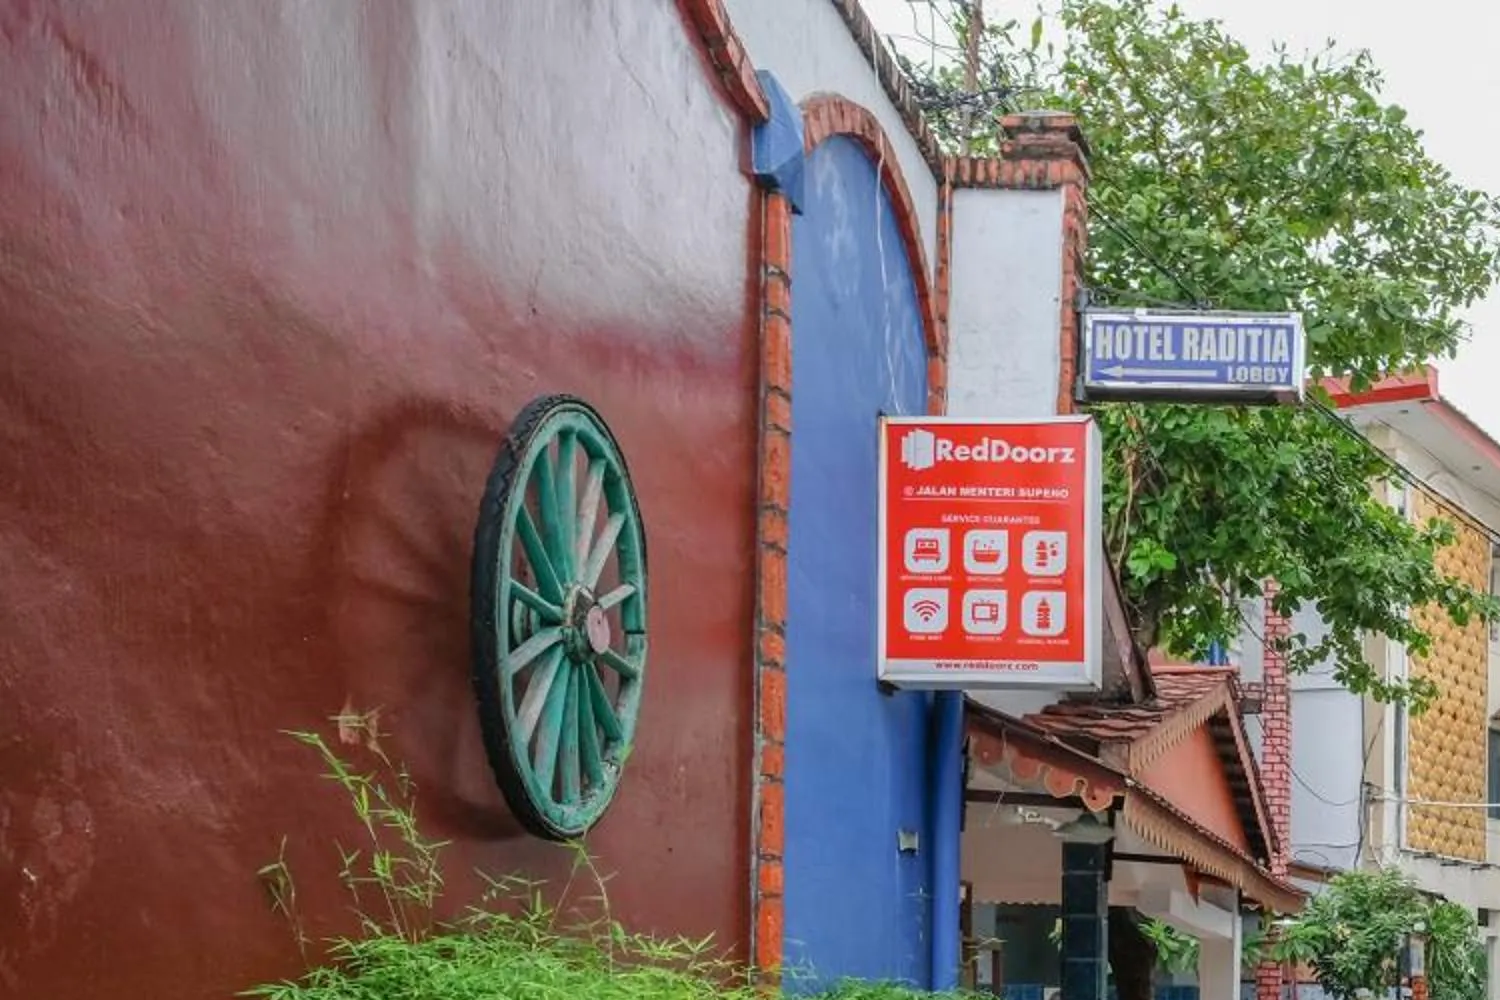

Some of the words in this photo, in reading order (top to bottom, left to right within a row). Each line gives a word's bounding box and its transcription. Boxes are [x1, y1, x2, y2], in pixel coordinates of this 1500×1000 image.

[1095, 324, 1176, 361] HOTEL
[1182, 327, 1290, 363] RADITIA
[1227, 366, 1289, 384] LOBBY
[936, 437, 1076, 463] RedDoorz
[916, 485, 957, 496] JALAN
[960, 486, 1015, 497] MENTERI
[1018, 487, 1069, 499] SUPENO
